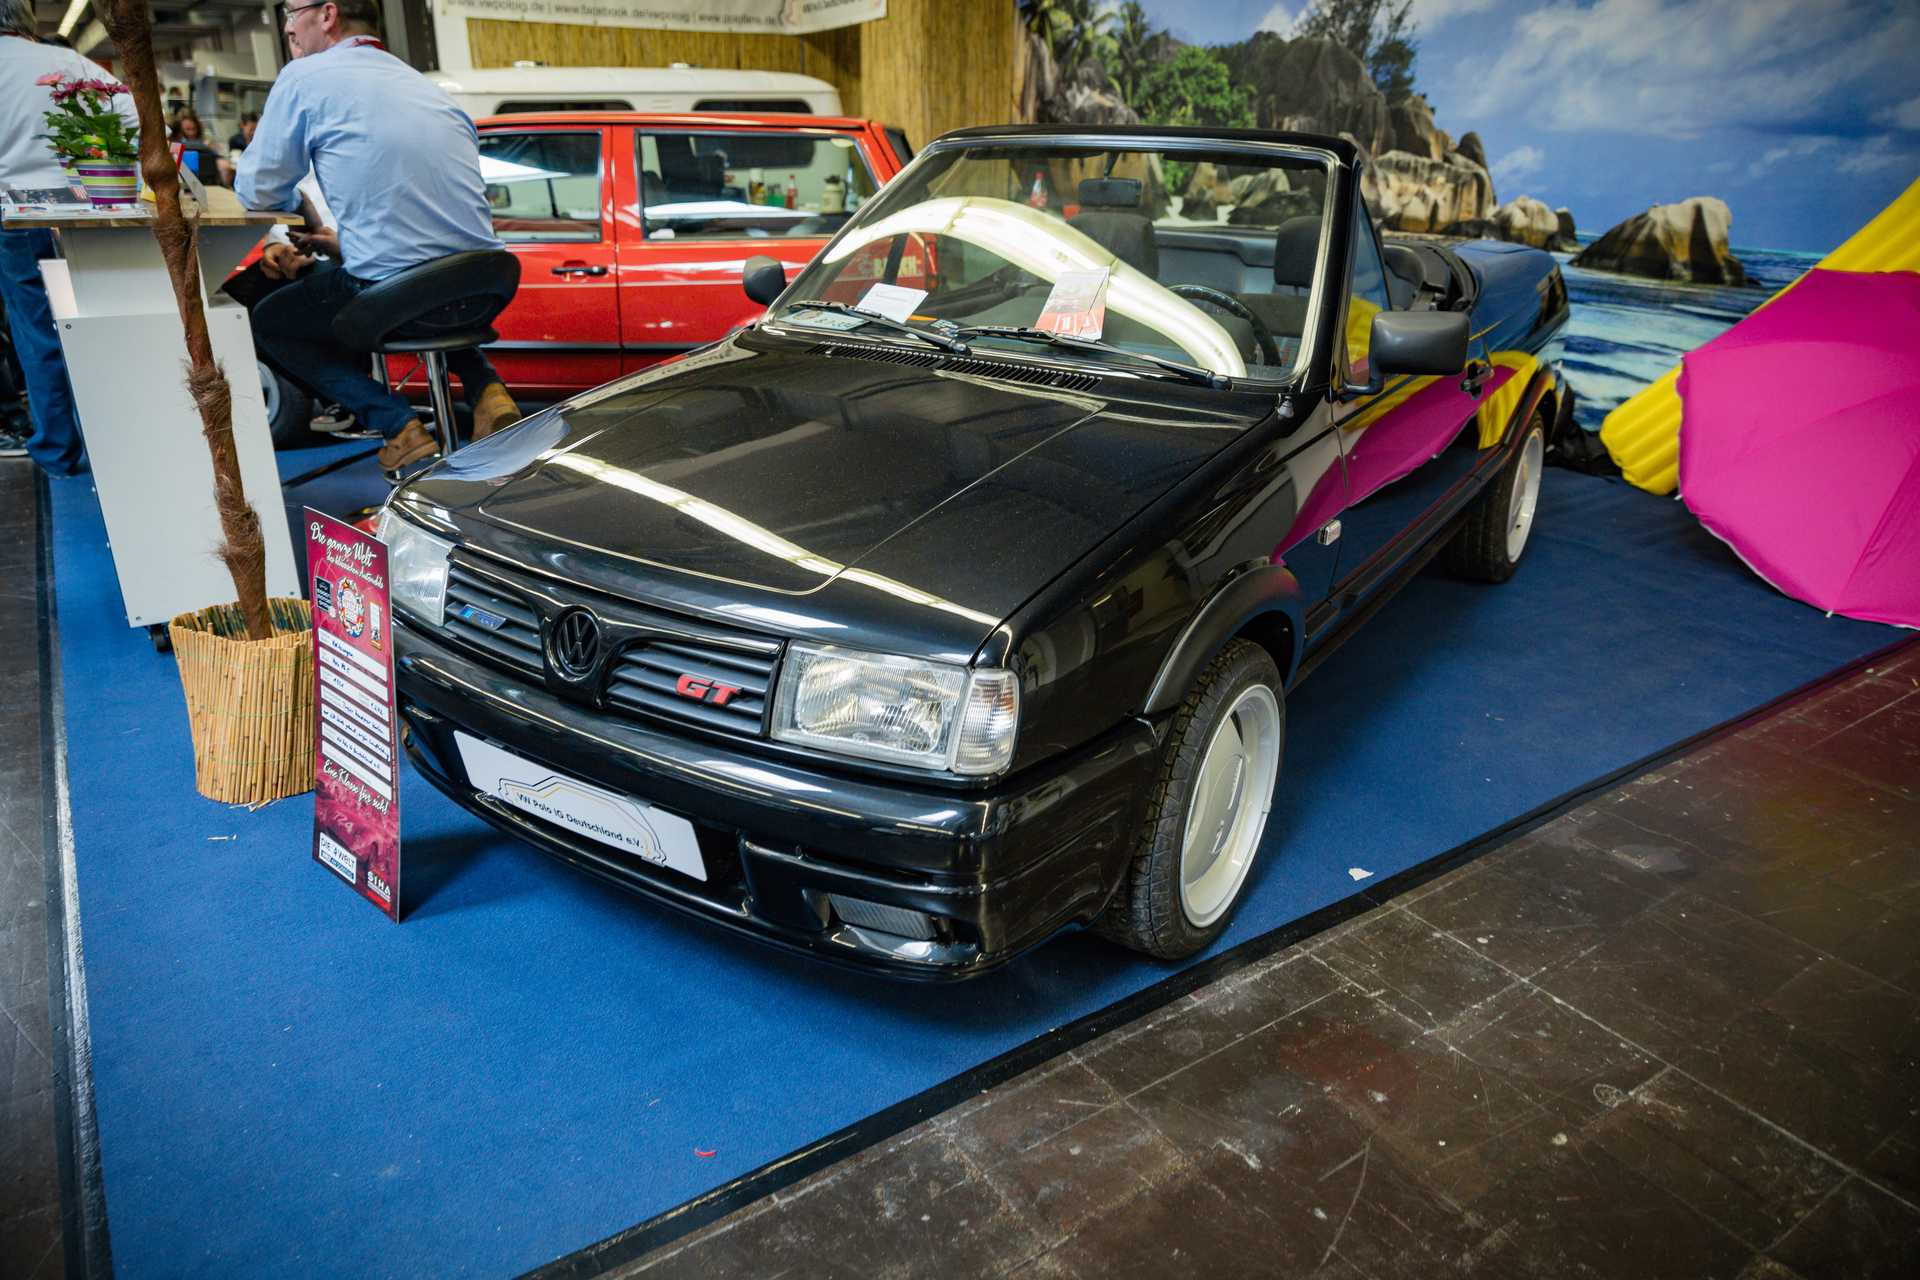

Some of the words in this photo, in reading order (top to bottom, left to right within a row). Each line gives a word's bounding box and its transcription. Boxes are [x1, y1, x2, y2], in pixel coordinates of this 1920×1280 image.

[310, 521, 327, 544] Die
[352, 542, 376, 567] Welt
[676, 674, 740, 704] GT
[533, 800, 552, 813] Polo
[553, 808, 564, 818] IG
[566, 814, 623, 840] Deutschland
